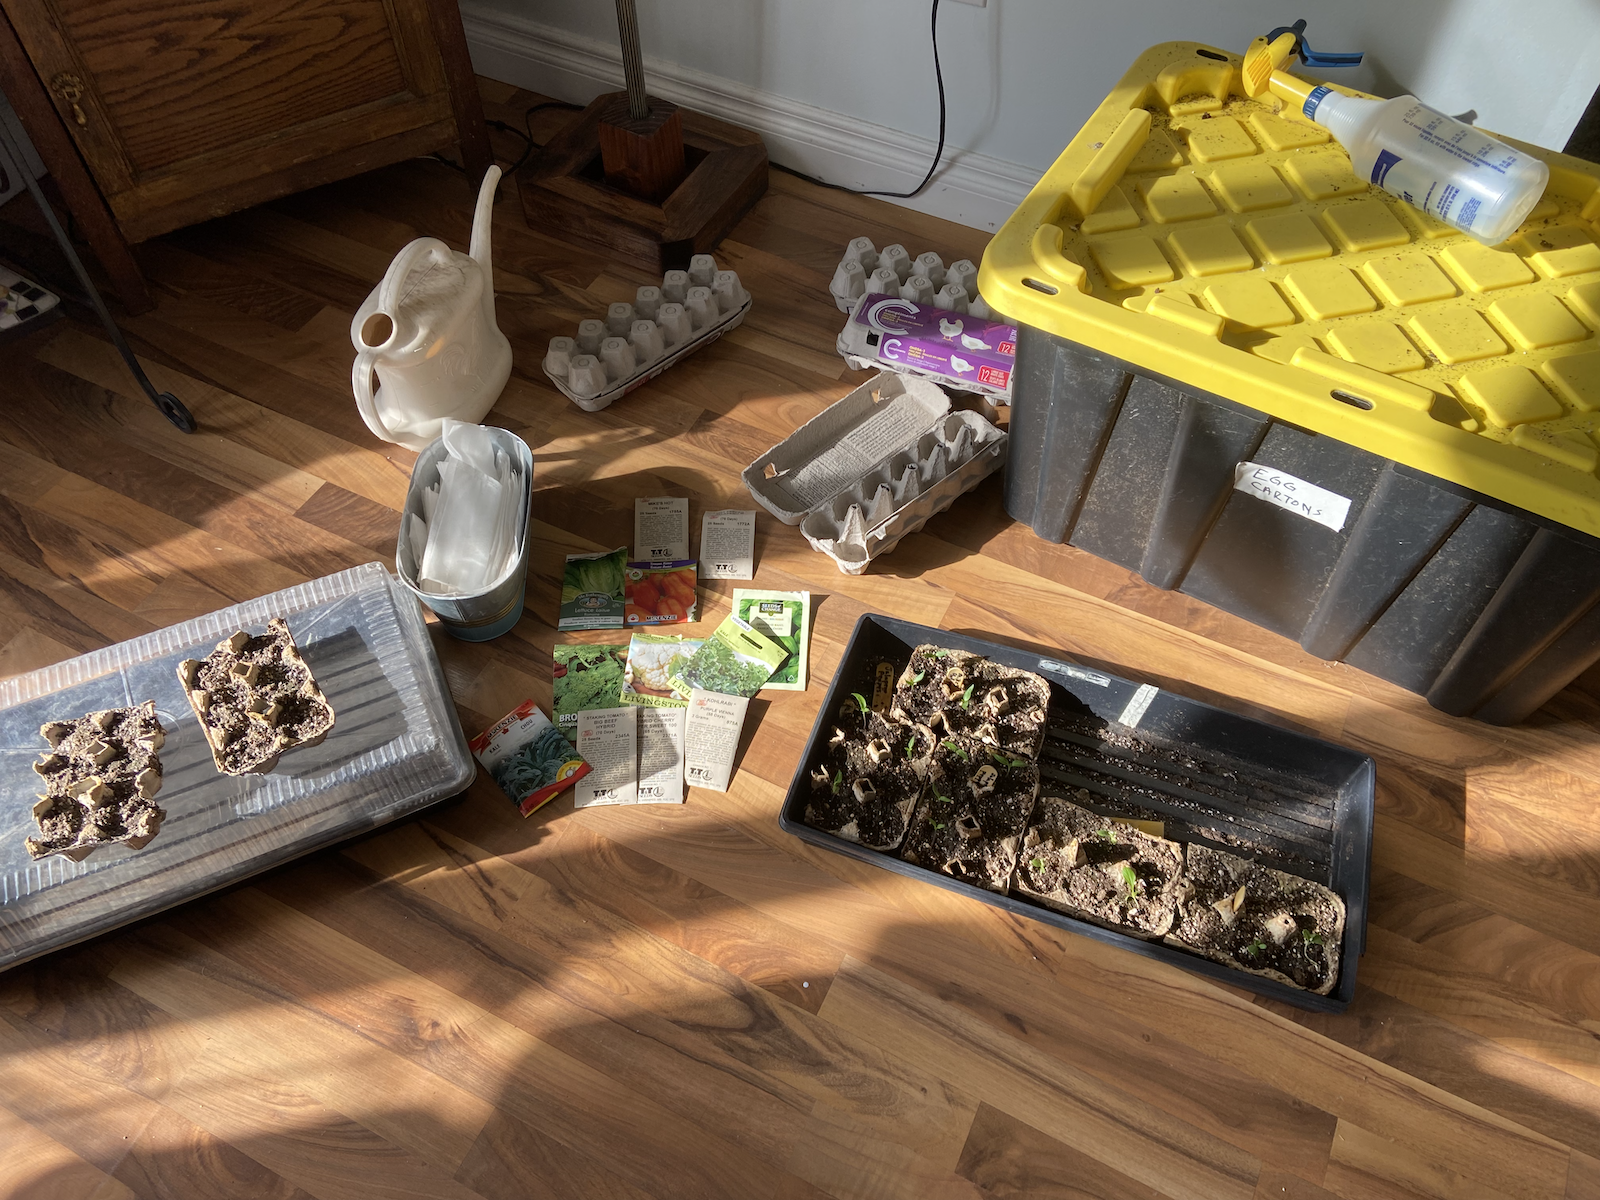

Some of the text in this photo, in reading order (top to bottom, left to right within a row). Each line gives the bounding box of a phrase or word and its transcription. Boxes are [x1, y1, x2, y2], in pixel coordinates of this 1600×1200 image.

[1001, 343, 1011, 353] 12
[981, 370, 990, 382] 12
[1252, 468, 1296, 492] EGG
[1251, 482, 1322, 516] CARTONS
[559, 713, 578, 722] BRO
[521, 719, 533, 730] CHOU
[489, 744, 500, 753] KALE
